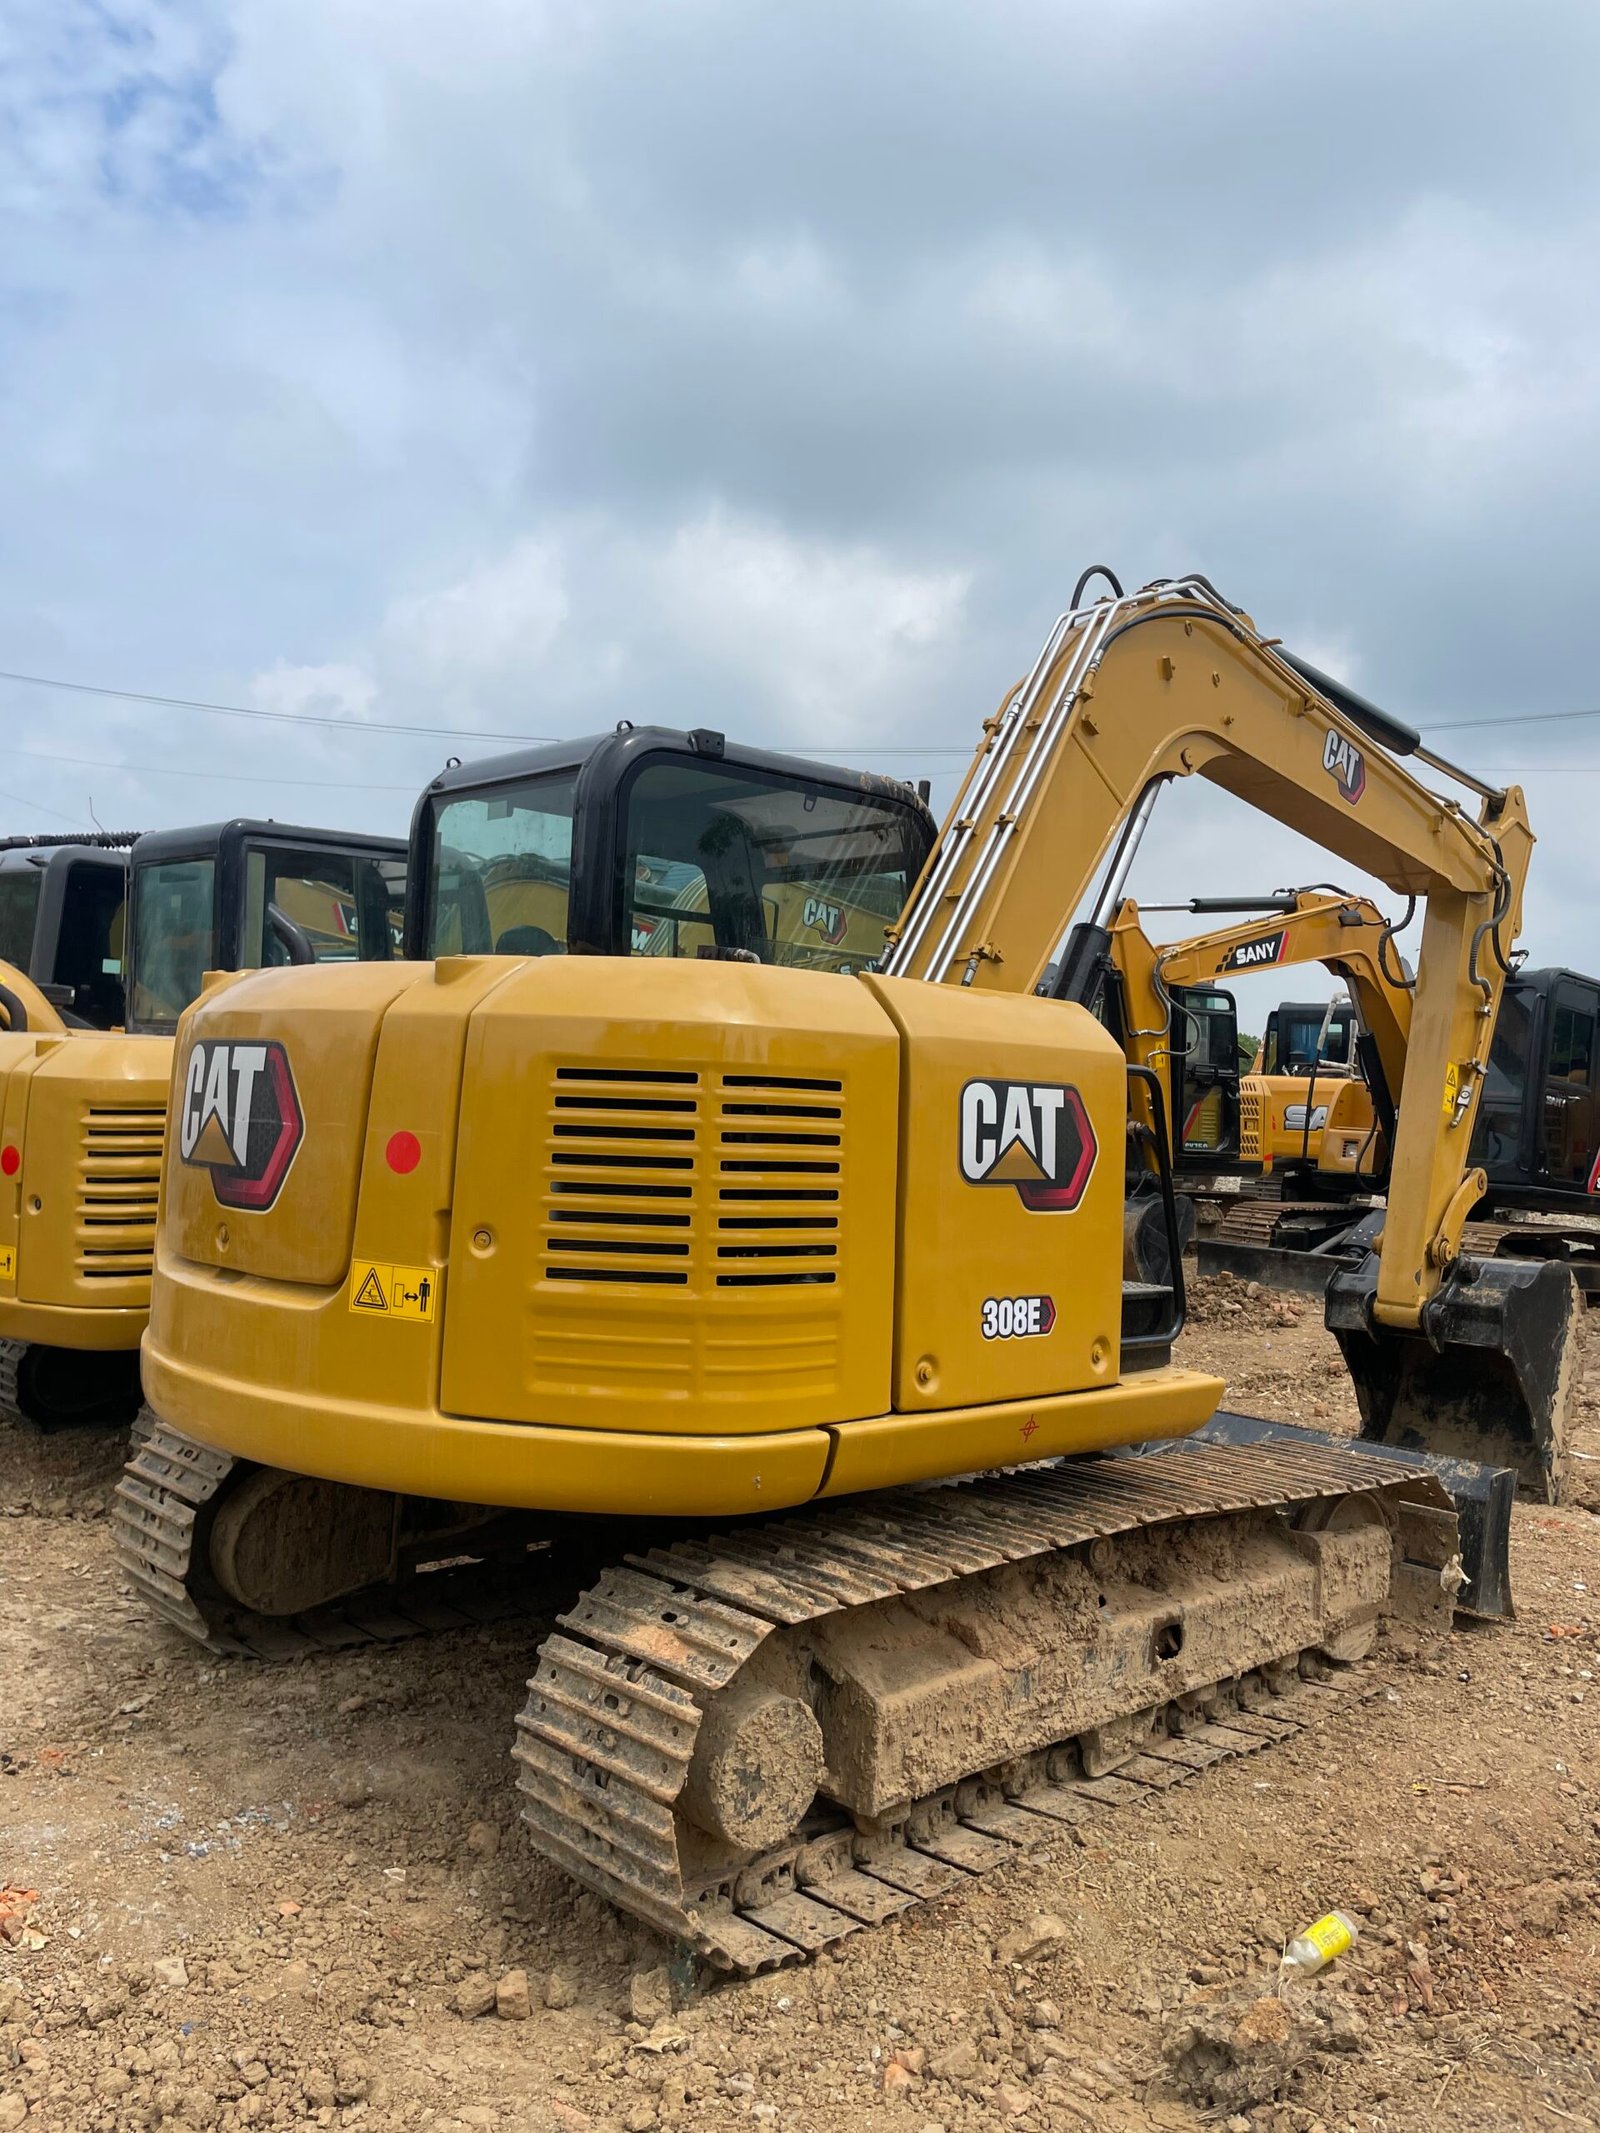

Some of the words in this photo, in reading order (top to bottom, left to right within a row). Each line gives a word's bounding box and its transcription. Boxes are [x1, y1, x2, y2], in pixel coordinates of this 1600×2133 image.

[1323, 729, 1360, 789] CAT
[803, 898, 839, 935] CAT
[1236, 941, 1276, 965] SANY
[180, 1043, 267, 1167] CAT
[962, 1082, 1065, 1180] CAT
[982, 1298, 1041, 1337] 308E
